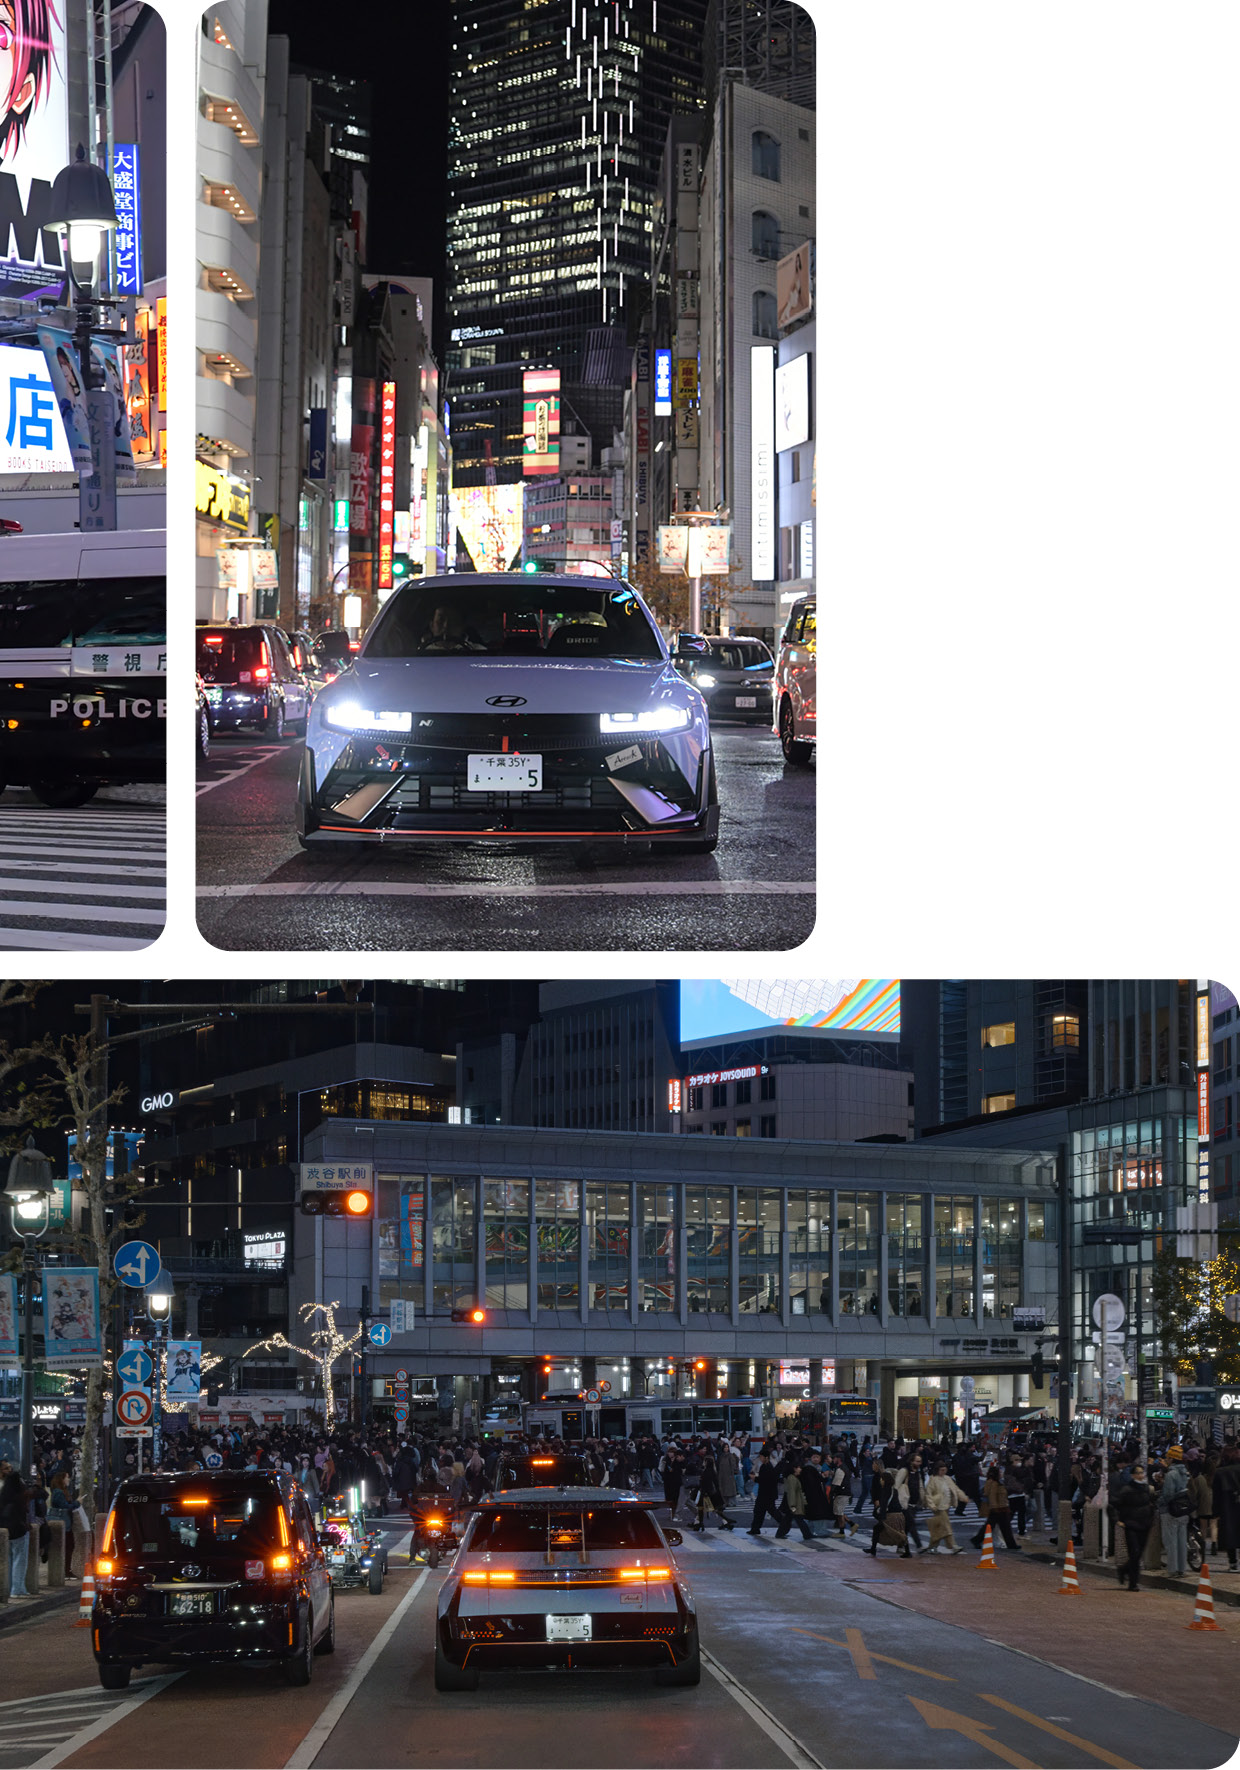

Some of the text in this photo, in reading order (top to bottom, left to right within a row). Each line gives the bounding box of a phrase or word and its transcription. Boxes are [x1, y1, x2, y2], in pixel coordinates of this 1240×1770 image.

[8, 457, 32, 469] BOOKS
[639, 461, 647, 505] SHIBUYA
[349, 451, 369, 531] 歌広場
[566, 636, 600, 644] BRIDE
[486, 757, 527, 767] 千葉 35Y
[528, 770, 538, 787] 5
[689, 1072, 719, 1087] カラオケ
[720, 1066, 757, 1082] JOYSOUND
[141, 1092, 173, 1113] GMO
[307, 1167, 366, 1180] 渋谷駅前
[316, 1181, 344, 1190] Shibuya
[244, 1231, 285, 1243] TOKYU PLAZA
[127, 1495, 149, 1503] 6218
[179, 1601, 212, 1614] 62-18
[583, 1625, 590, 1636] 5
